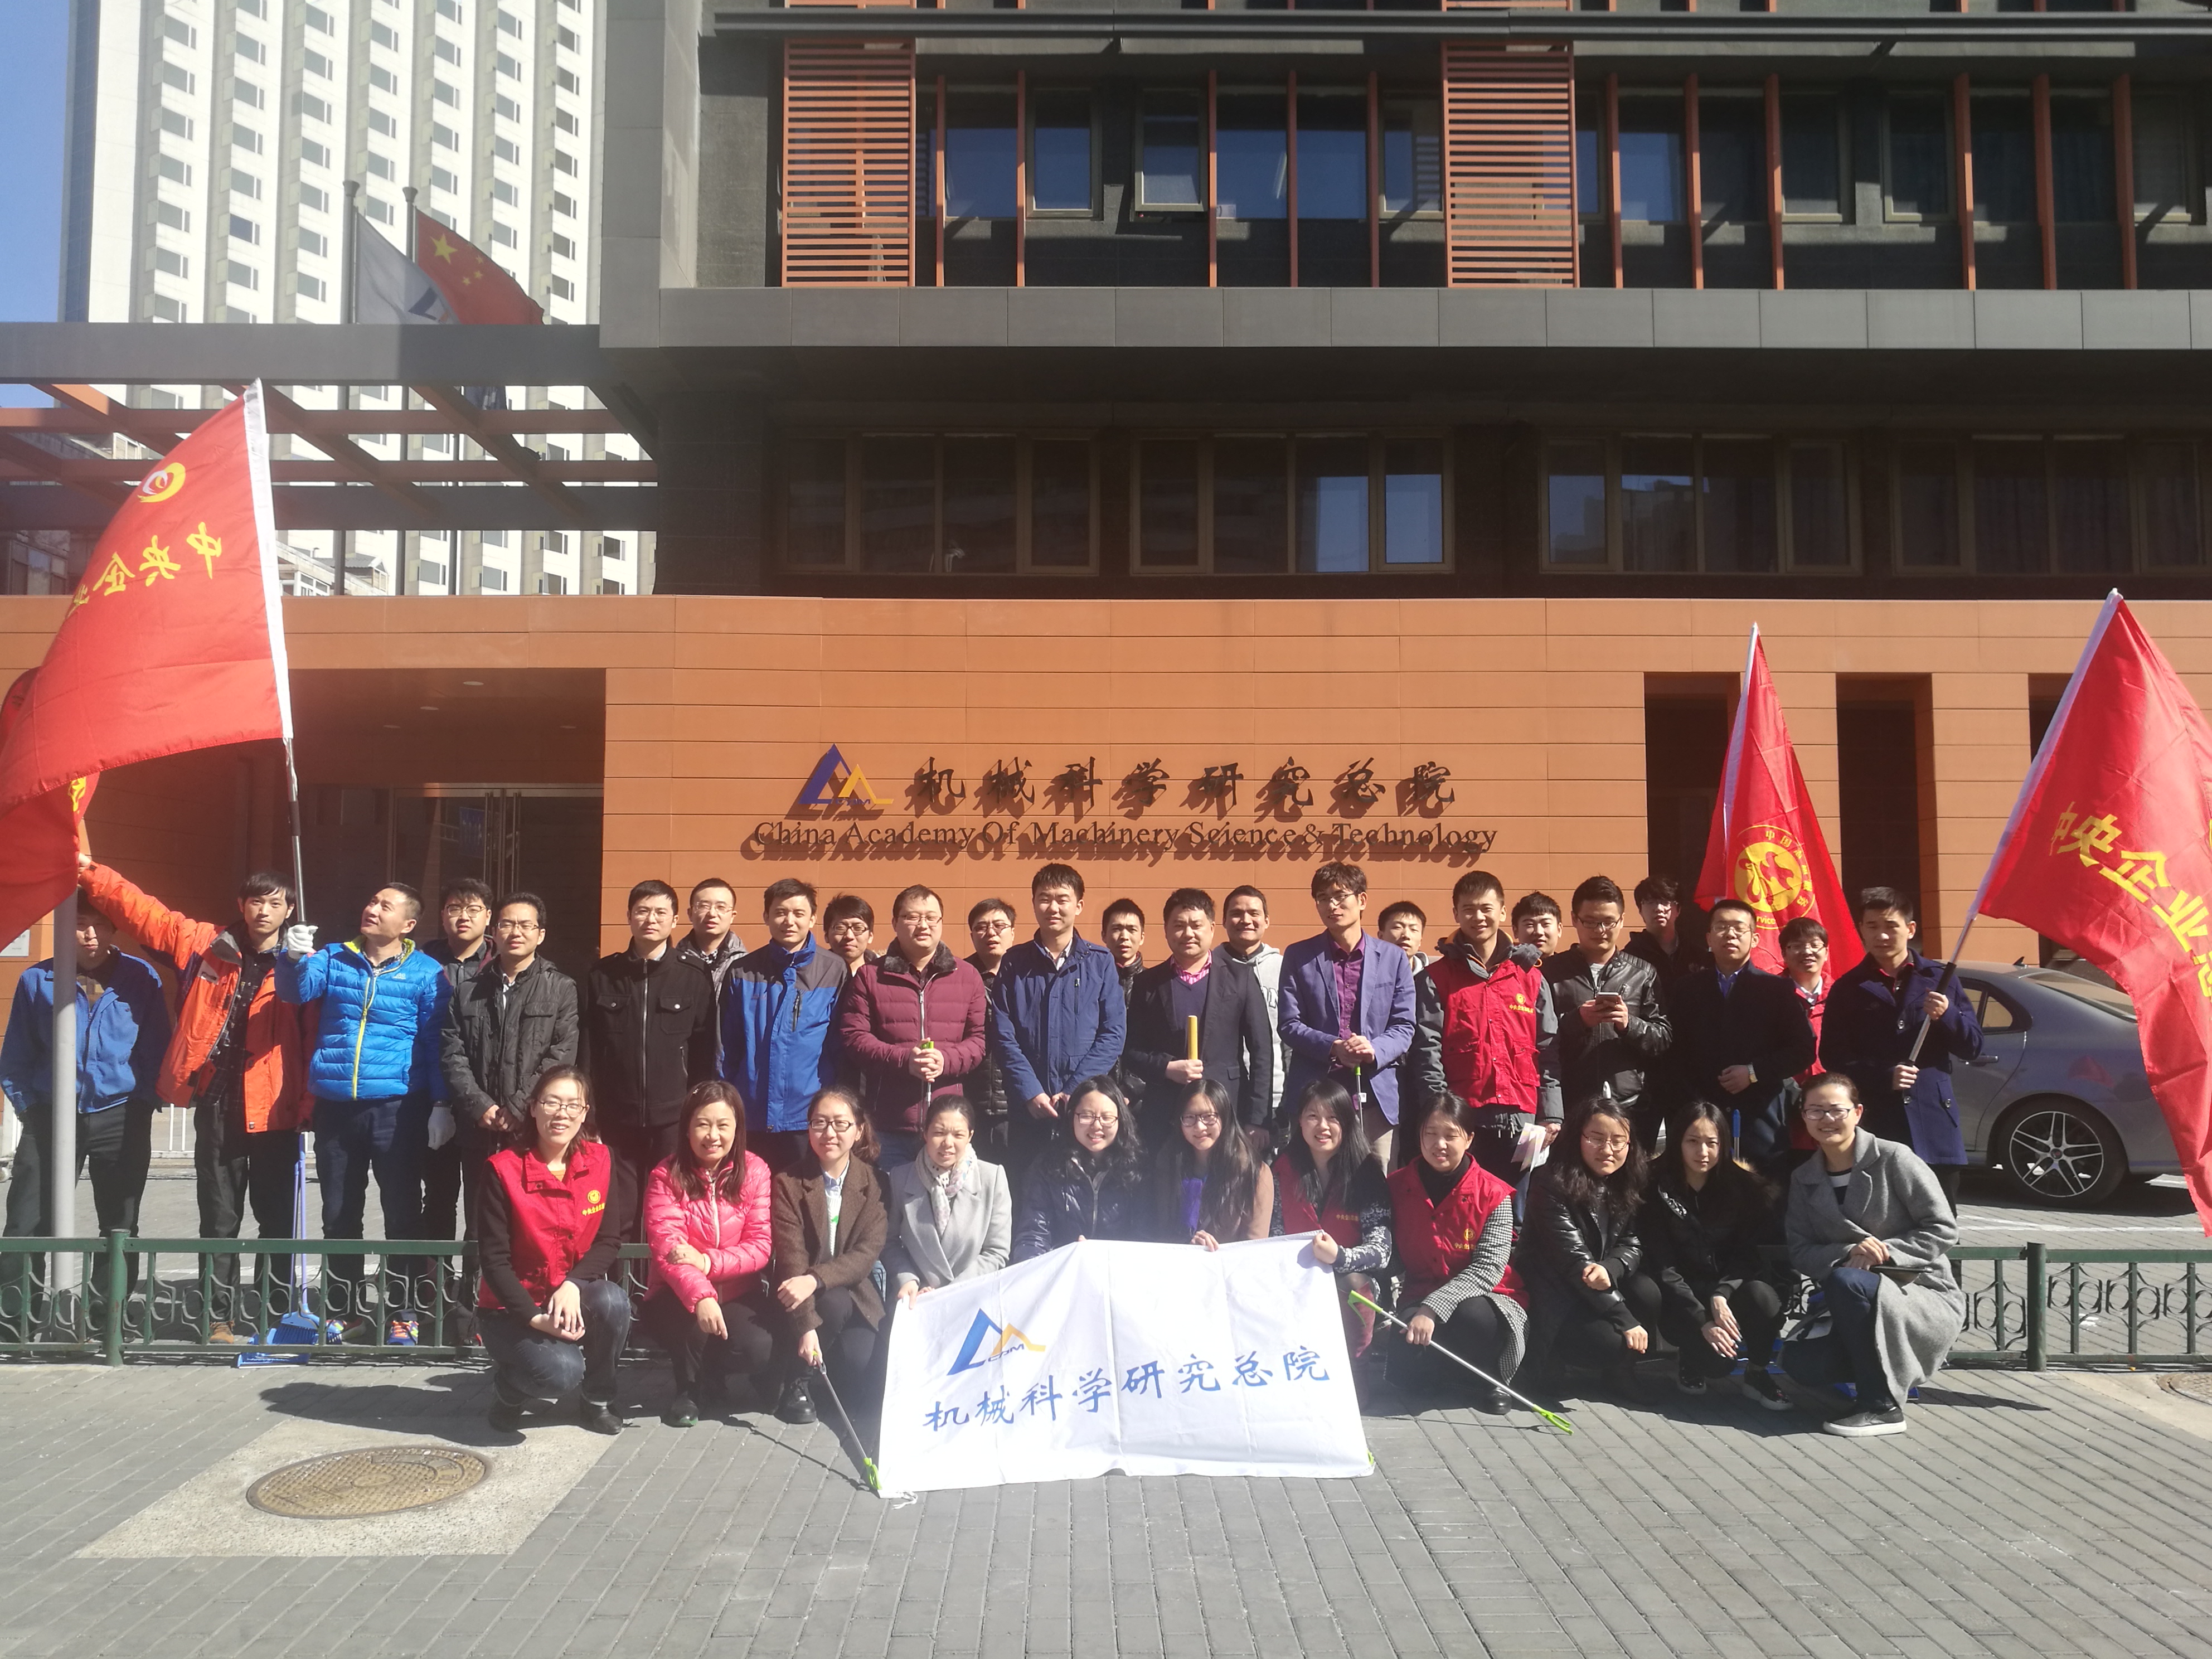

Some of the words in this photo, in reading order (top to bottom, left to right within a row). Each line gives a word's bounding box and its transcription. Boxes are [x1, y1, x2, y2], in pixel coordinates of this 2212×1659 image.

[918, 756, 1455, 807] 机械科学研究总院
[754, 821, 836, 846] China
[843, 822, 976, 851] Academy
[984, 821, 1020, 845] Of
[1032, 821, 1180, 851] Machinery
[1190, 821, 1297, 845] Science
[1303, 823, 1324, 845] &
[1332, 822, 1497, 853] Technology
[923, 1345, 1331, 1432] 机械科学研究总院
